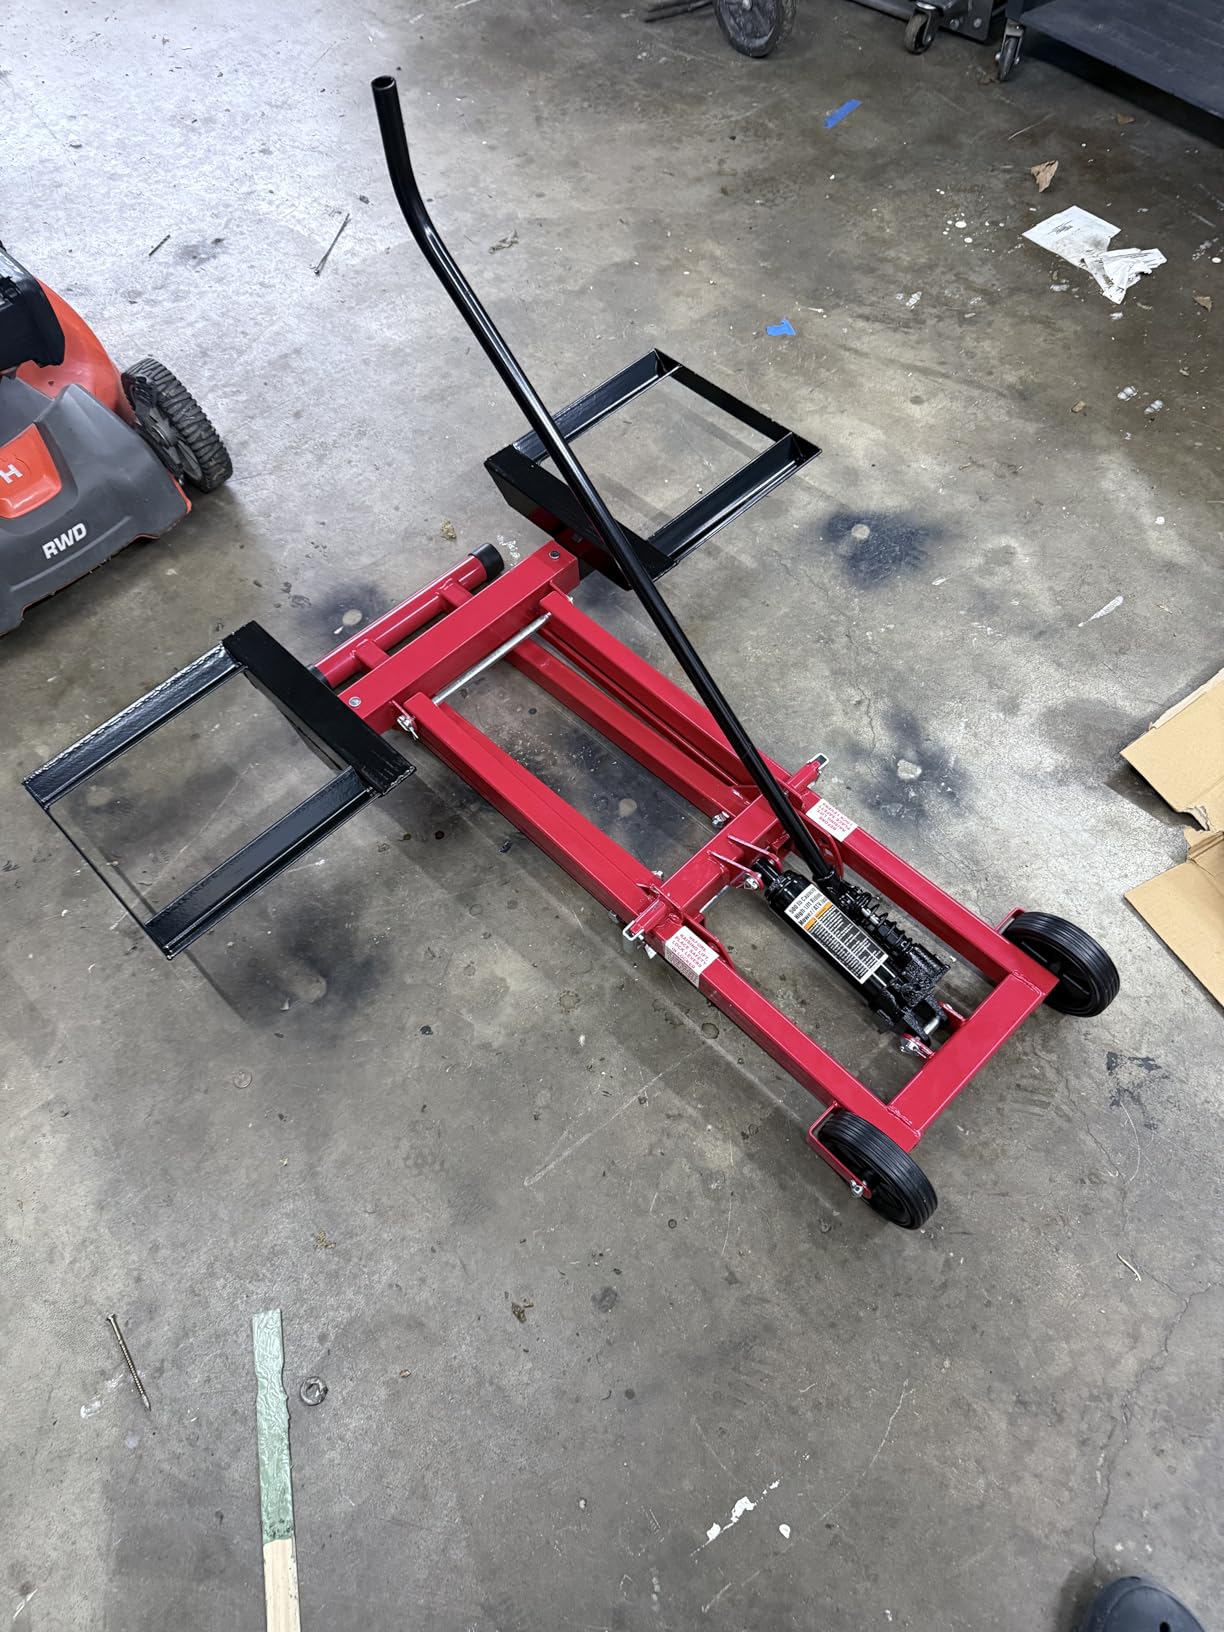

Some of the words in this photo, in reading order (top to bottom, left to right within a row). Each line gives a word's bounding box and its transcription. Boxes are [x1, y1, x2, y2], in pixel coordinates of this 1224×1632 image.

[42, 523, 87, 559] RWD
[794, 909, 806, 920] High
[672, 941, 685, 952] LOCK
[685, 952, 702, 968] LEVERS
[675, 937, 689, 949] PLACE
[690, 950, 707, 965] SAFETY
[680, 935, 699, 951] RAISING
